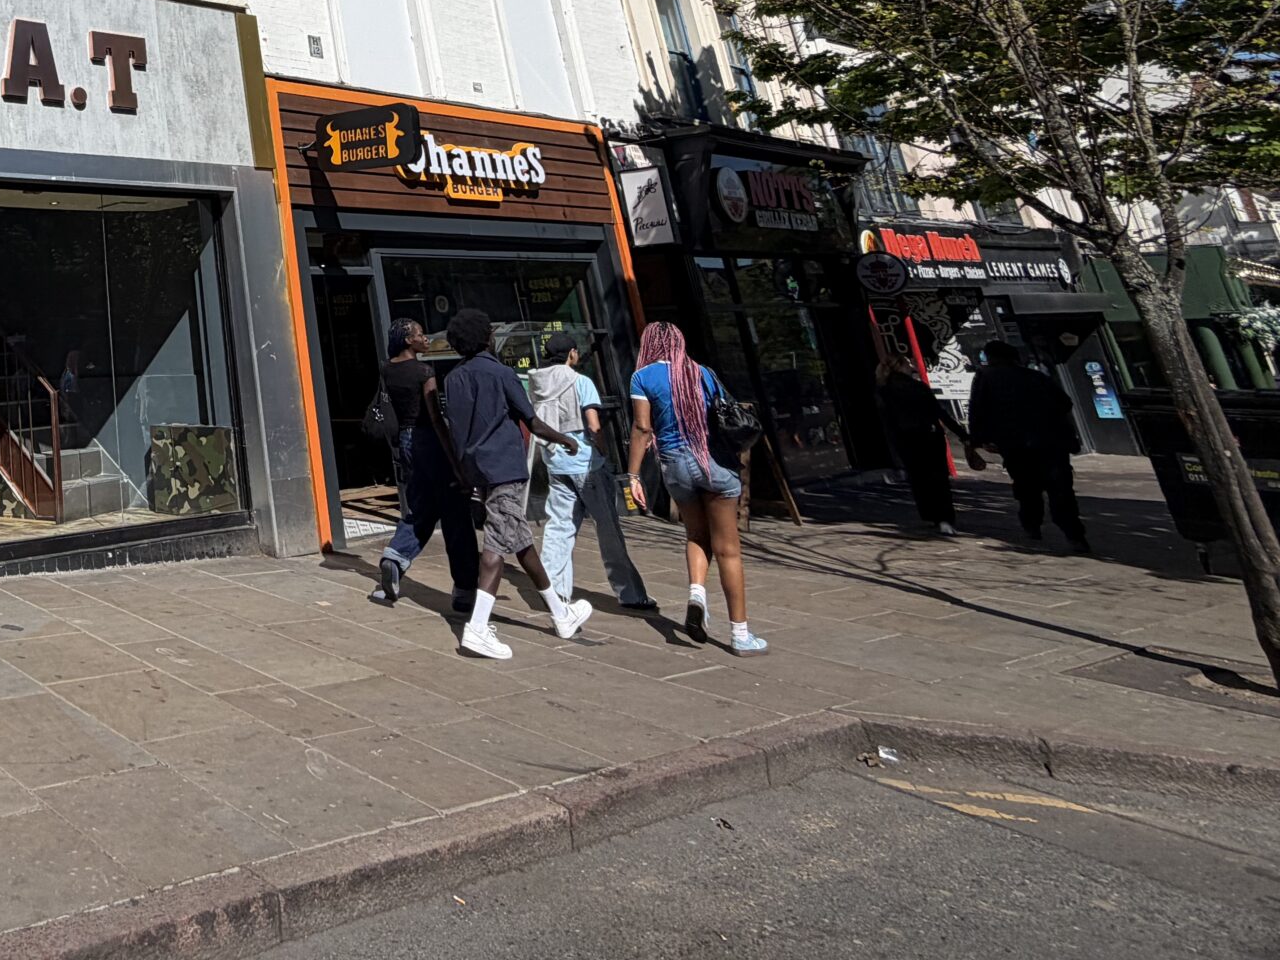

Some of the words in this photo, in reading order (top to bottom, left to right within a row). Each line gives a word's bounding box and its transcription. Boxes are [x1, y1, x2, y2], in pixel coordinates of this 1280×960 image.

[452, 184, 500, 197] BURGER
[985, 261, 1025, 278] LEMENT
[1027, 262, 1059, 278] GAMES
